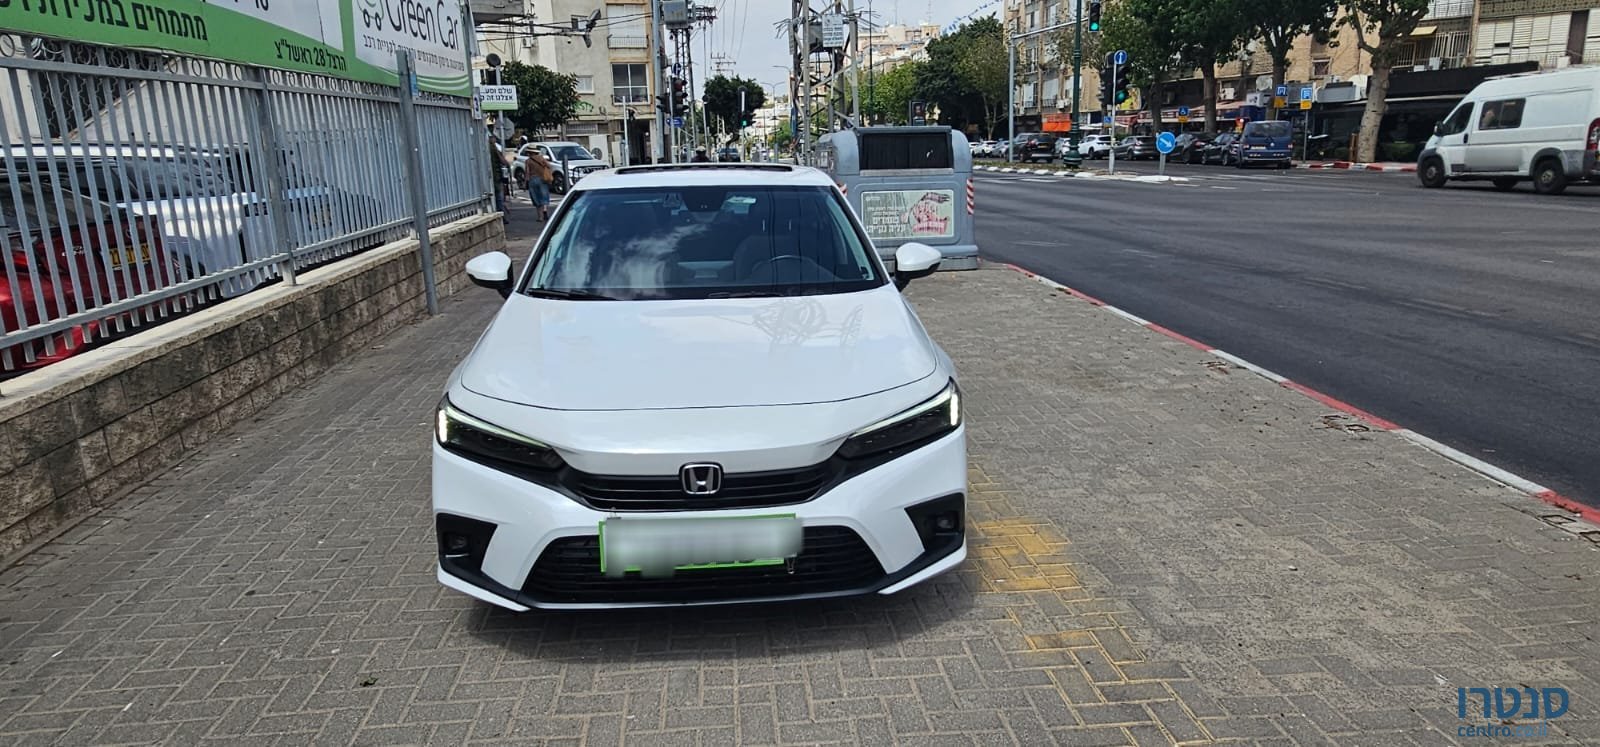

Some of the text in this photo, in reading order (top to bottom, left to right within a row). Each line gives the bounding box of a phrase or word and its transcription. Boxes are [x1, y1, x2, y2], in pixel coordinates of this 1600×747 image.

[131, 2, 208, 41] מתמחים
[385, 0, 460, 51] Green Car
[363, 34, 376, 49] רכב
[314, 47, 326, 67] 28
[326, 49, 346, 72] הרצל
